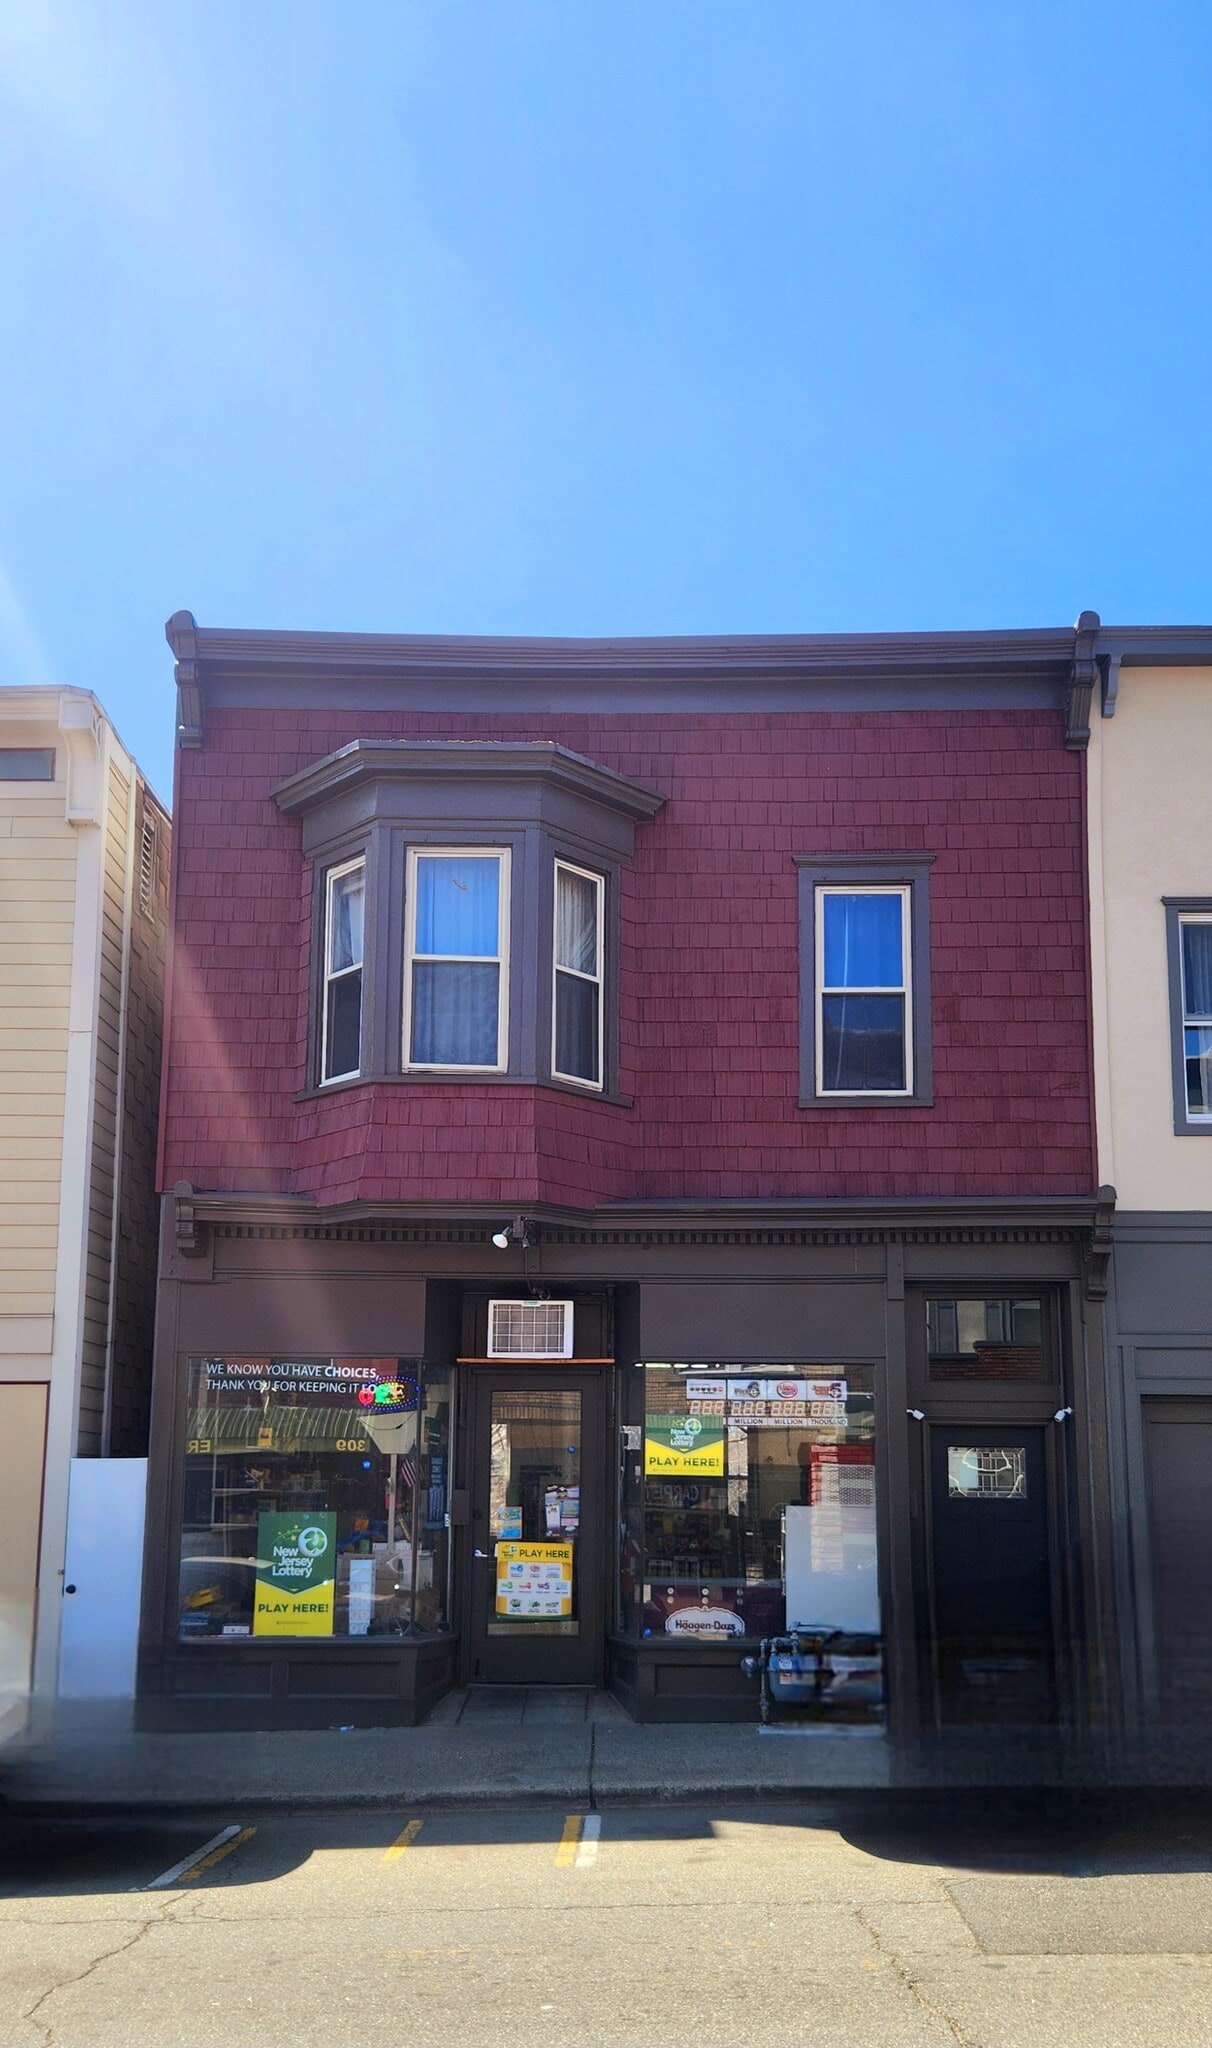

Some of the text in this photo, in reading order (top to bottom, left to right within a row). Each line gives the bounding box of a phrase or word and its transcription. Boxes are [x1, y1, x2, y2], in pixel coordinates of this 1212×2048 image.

[206, 1364, 380, 1381] WE KNOW YOU HAVE CHOICES,
[206, 1379, 244, 1390] THANK
[247, 1380, 270, 1391] YOU
[274, 1380, 296, 1392] FOR
[299, 1381, 348, 1393] KEEPING
[350, 1383, 359, 1393] IT
[649, 1457, 719, 1467] PLAY HERE!
[273, 1546, 299, 1556] New
[520, 1549, 543, 1558] PLAY
[545, 1551, 570, 1559] HERE
[278, 1556, 314, 1568] Jersey
[272, 1565, 313, 1578] Lottery
[258, 1604, 329, 1613] PLAY HERE!
[675, 1619, 736, 1632] Häagen-Dazs
